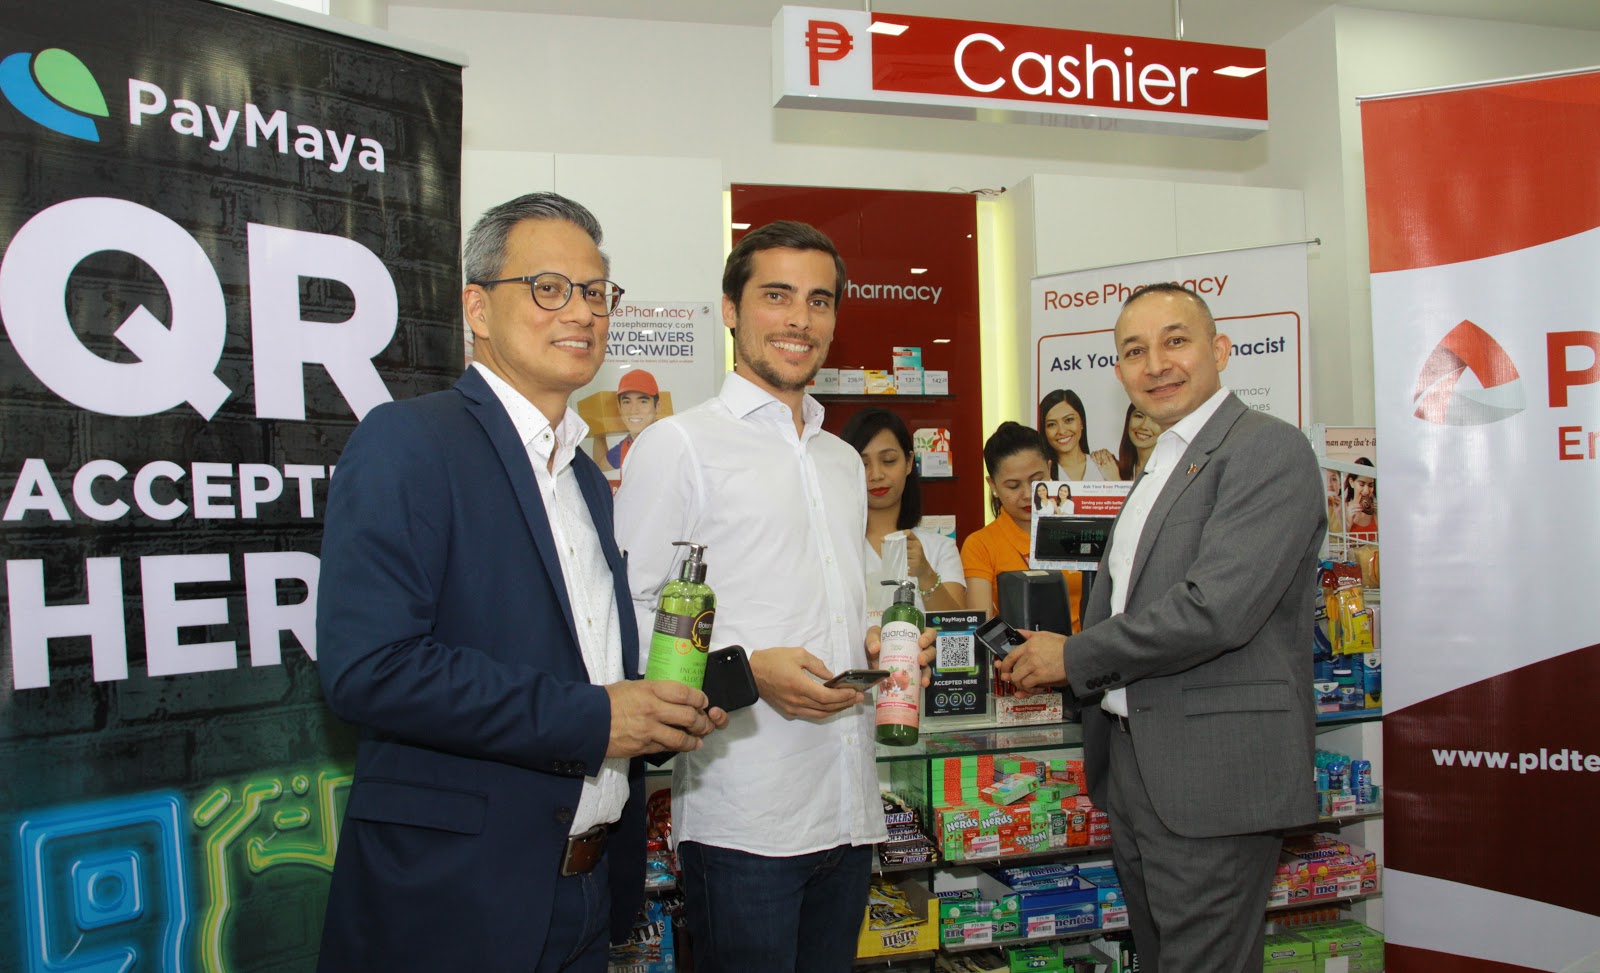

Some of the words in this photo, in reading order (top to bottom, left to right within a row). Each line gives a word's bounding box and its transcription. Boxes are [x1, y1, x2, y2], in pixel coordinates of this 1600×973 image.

[954, 32, 1199, 107] Cashier
[128, 78, 386, 173] PayMaya
[845, 279, 943, 304] harmacy
[1044, 290, 1099, 310] Rose
[1103, 274, 1229, 303] Phaacy
[0, 196, 399, 422] QR
[610, 320, 694, 329] .rosepharmacy.com
[628, 331, 694, 343] DELIVERS
[604, 343, 694, 356] ATIONWIDE!
[1050, 354, 1082, 372] Ask
[1087, 353, 1119, 368] You
[1340, 440, 1353, 449] ang
[2, 458, 337, 521] ACCEPT
[6, 551, 321, 690] HER
[941, 616, 966, 624] PayMaya
[966, 615, 978, 623] QR
[881, 628, 918, 640] guardian
[933, 679, 963, 687] ACCEPTED
[885, 812, 913, 824] ICKERS
